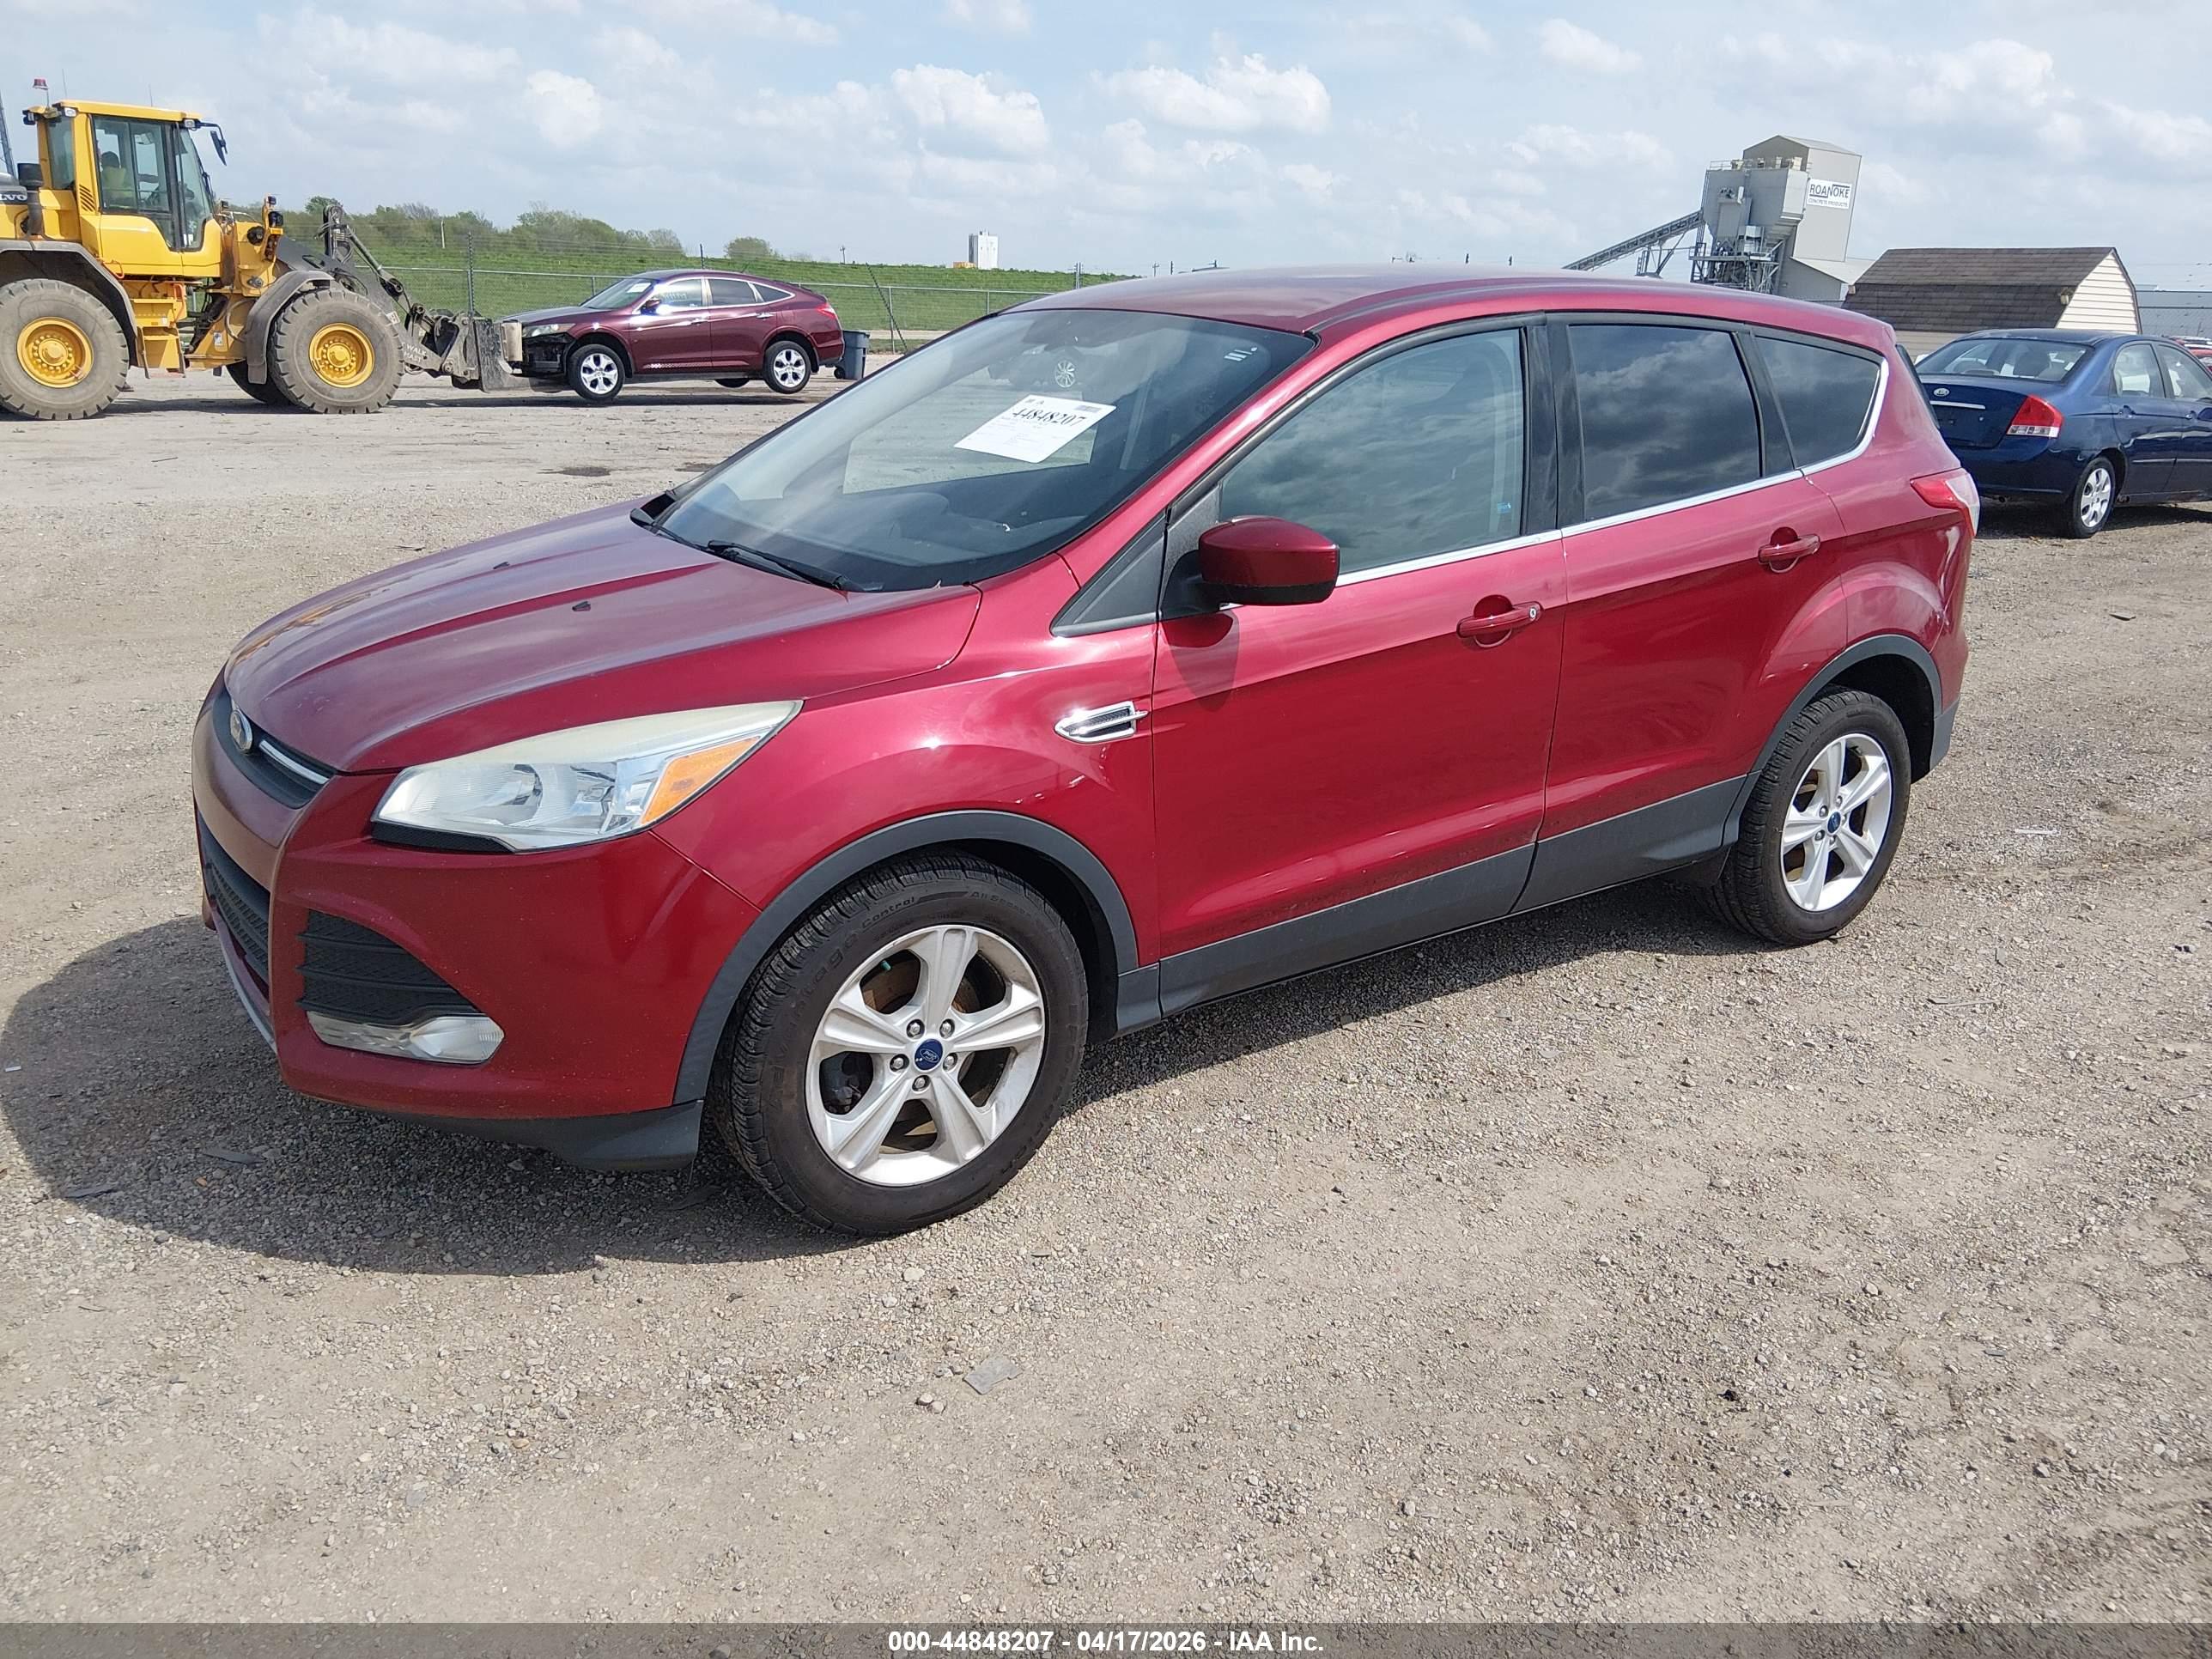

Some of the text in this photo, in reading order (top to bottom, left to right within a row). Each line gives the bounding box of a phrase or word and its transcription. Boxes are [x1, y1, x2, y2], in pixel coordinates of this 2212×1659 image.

[1809, 184, 1850, 198] ROANOKE
[406, 343, 427, 356] WALK
[1012, 407, 1087, 427] 44848207
[861, 896, 915, 929] Control
